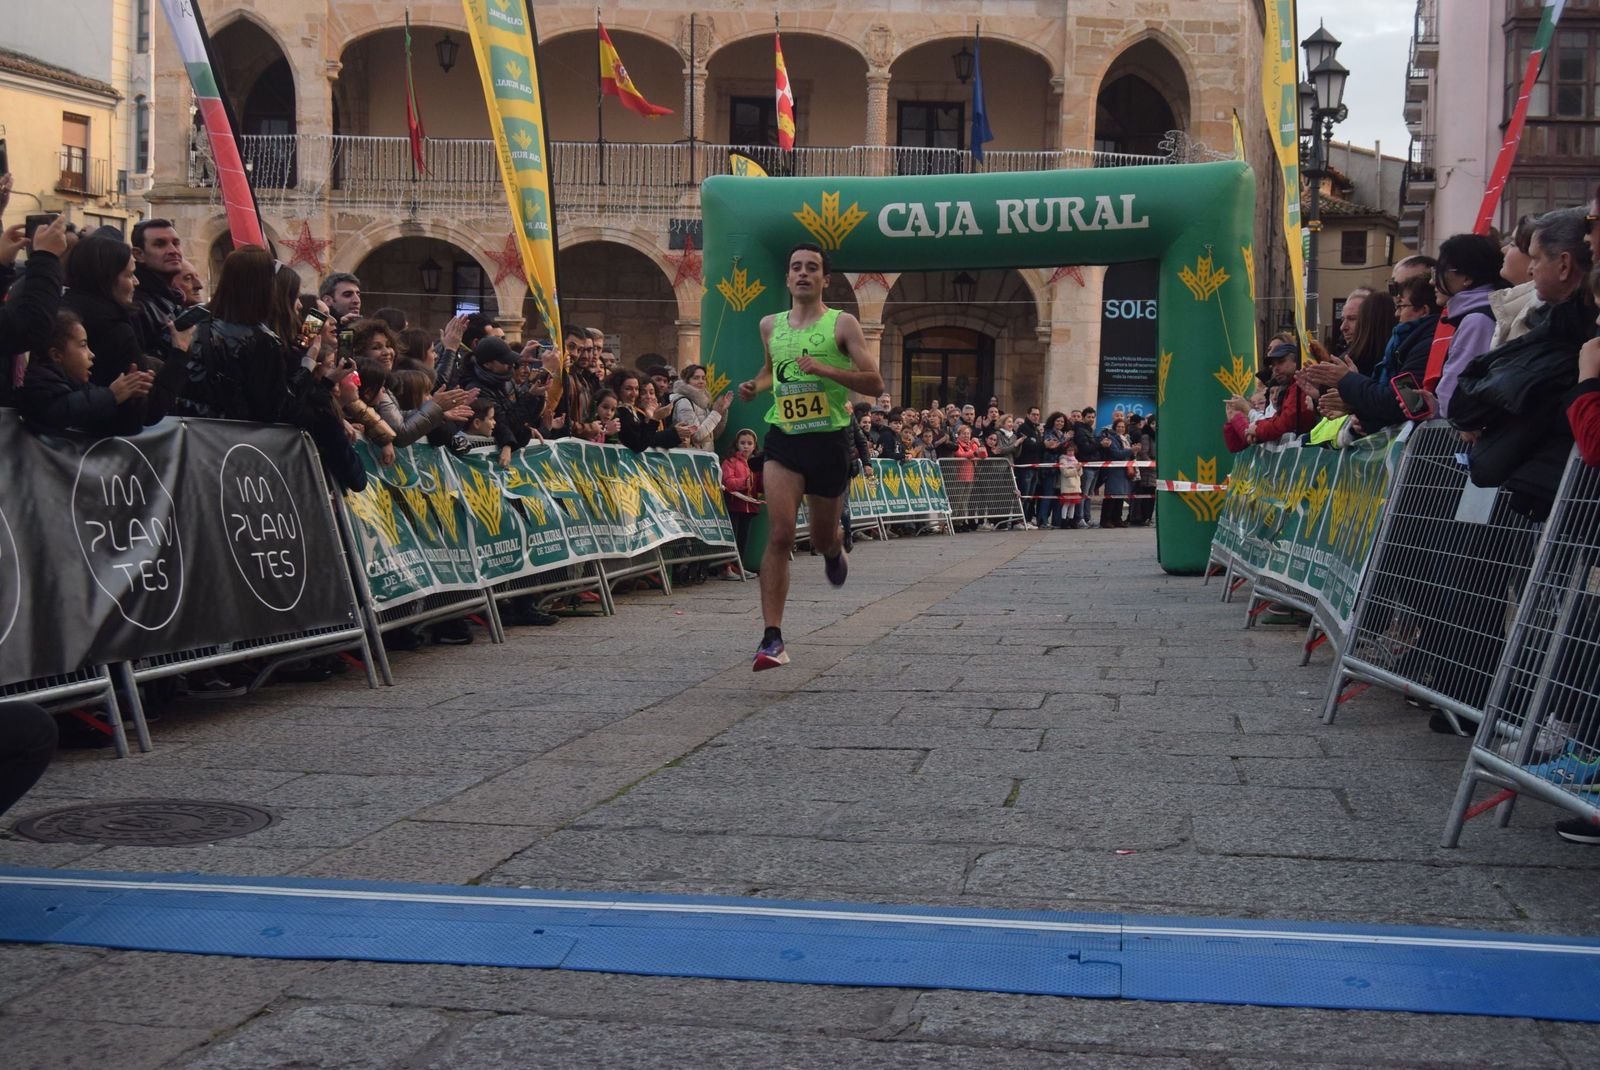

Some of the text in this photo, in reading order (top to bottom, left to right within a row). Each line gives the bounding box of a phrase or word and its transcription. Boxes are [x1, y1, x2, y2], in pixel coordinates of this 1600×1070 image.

[878, 193, 1149, 239] CAJA RURAL
[783, 395, 824, 420] 854
[808, 420, 830, 428] RURAL
[101, 474, 146, 506] IM
[236, 476, 274, 503] IM
[494, 538, 521, 556] RURAL
[112, 558, 169, 592] TES
[250, 551, 296, 579] TES
[366, 556, 399, 578] CAJA
[384, 574, 398, 588] DE
